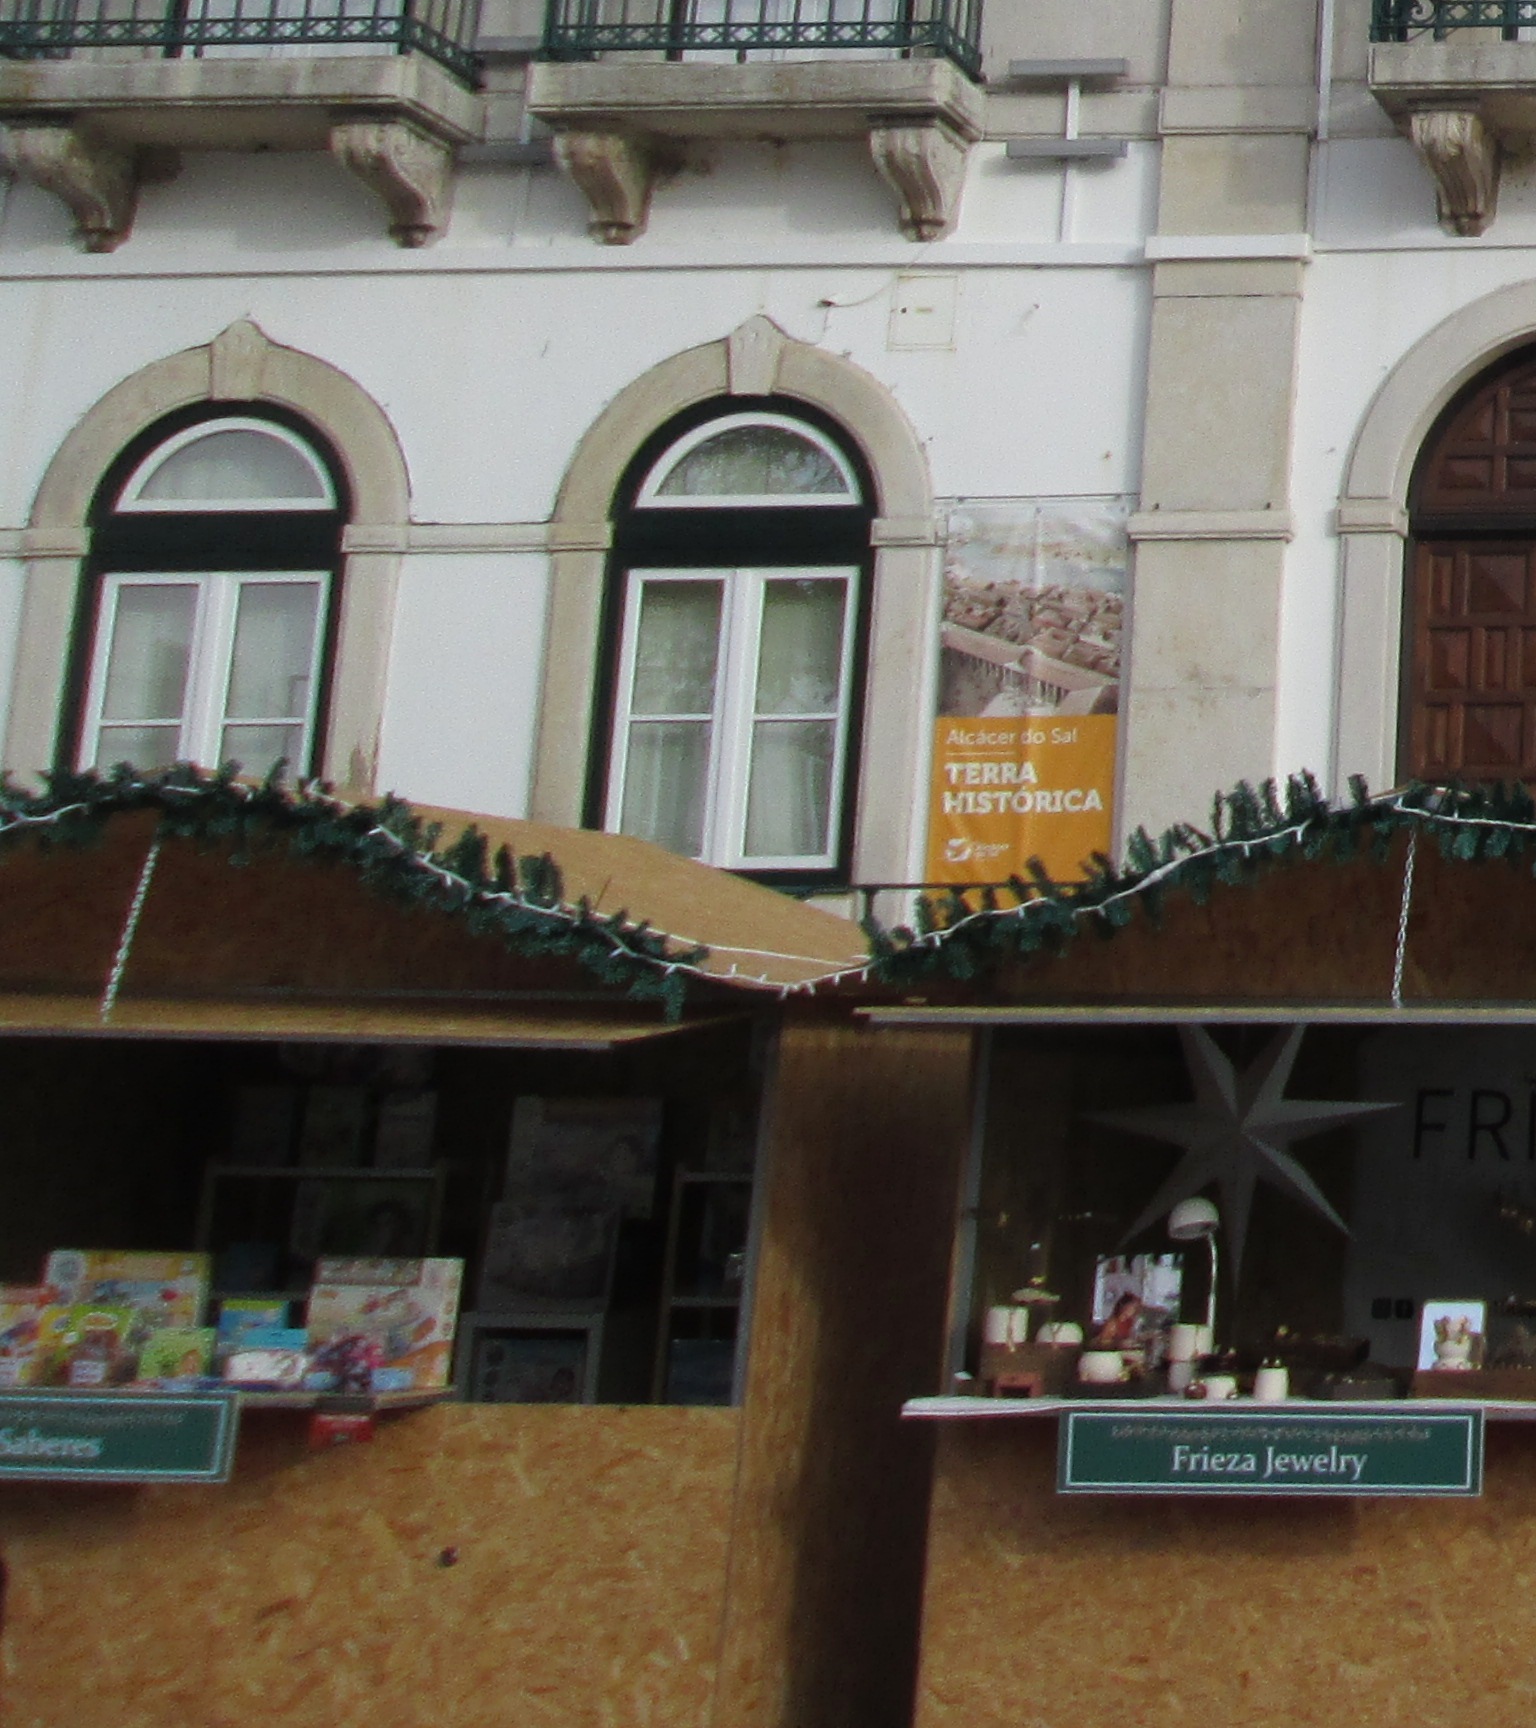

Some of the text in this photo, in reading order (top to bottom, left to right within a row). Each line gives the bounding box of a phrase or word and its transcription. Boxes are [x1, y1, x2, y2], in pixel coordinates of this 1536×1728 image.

[946, 727, 1077, 745] Alcácer do Sal
[944, 761, 1038, 784] TERRA
[942, 786, 1102, 814] HISTÓRICA
[1171, 1445, 1369, 1480] Frieza Jewelry
